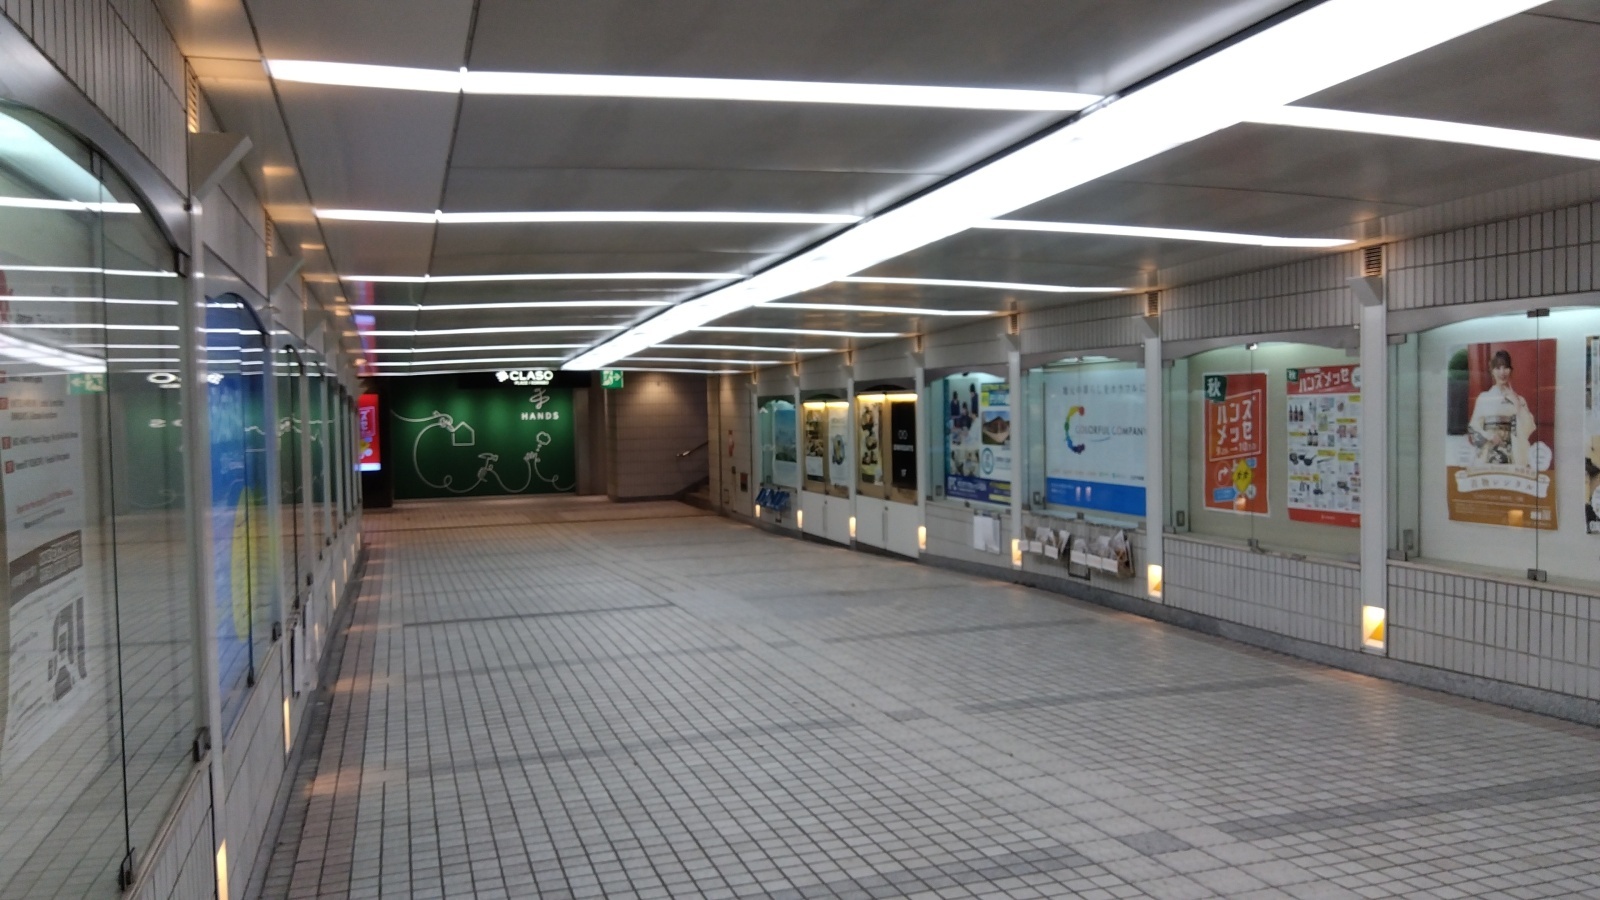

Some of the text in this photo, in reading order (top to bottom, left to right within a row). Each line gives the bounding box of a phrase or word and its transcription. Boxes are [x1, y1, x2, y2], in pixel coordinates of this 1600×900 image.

[509, 370, 554, 381] CLASO
[1299, 368, 1350, 393] ハンズメッセ
[1206, 377, 1222, 398] 秋
[521, 411, 559, 420] HANDS
[1217, 397, 1256, 425] ハンズ
[1075, 424, 1110, 435] COLORFUL
[1217, 421, 1253, 446] メッセ
